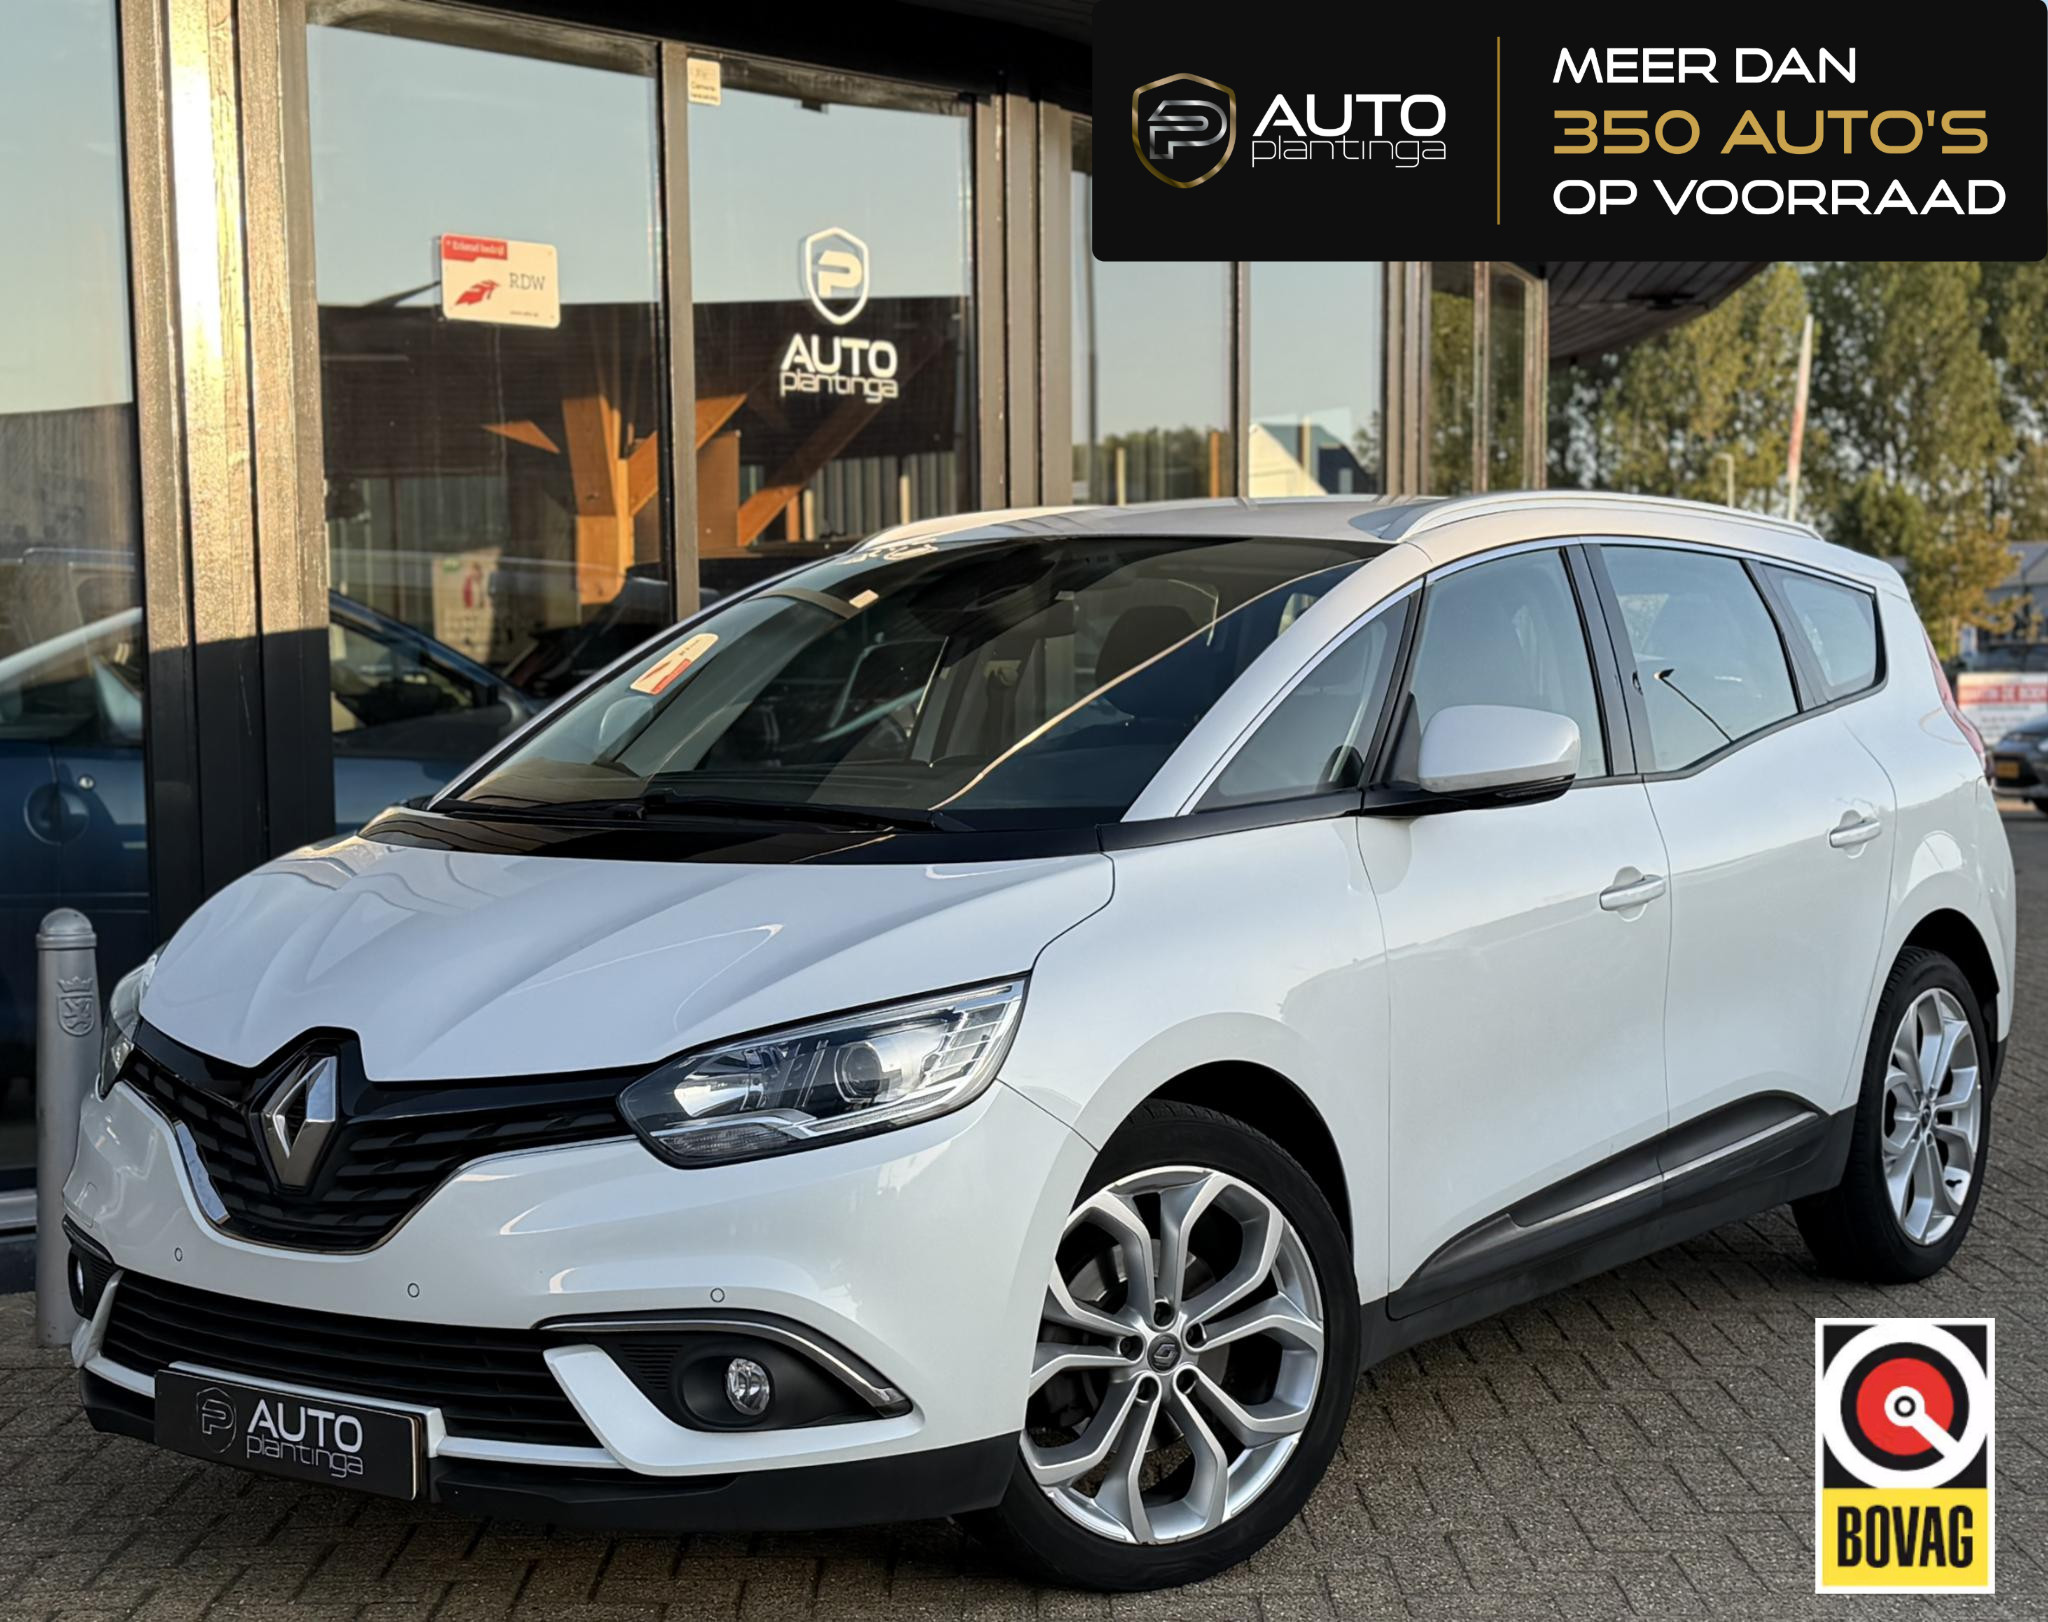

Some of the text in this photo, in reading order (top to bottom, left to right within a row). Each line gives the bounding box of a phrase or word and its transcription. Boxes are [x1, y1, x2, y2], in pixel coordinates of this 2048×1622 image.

[509, 272, 546, 291] RDW
[781, 333, 898, 378] AUTO
[780, 369, 898, 403] plantinga
[247, 1399, 363, 1453] AUTO
[246, 1434, 363, 1478] plantinga
